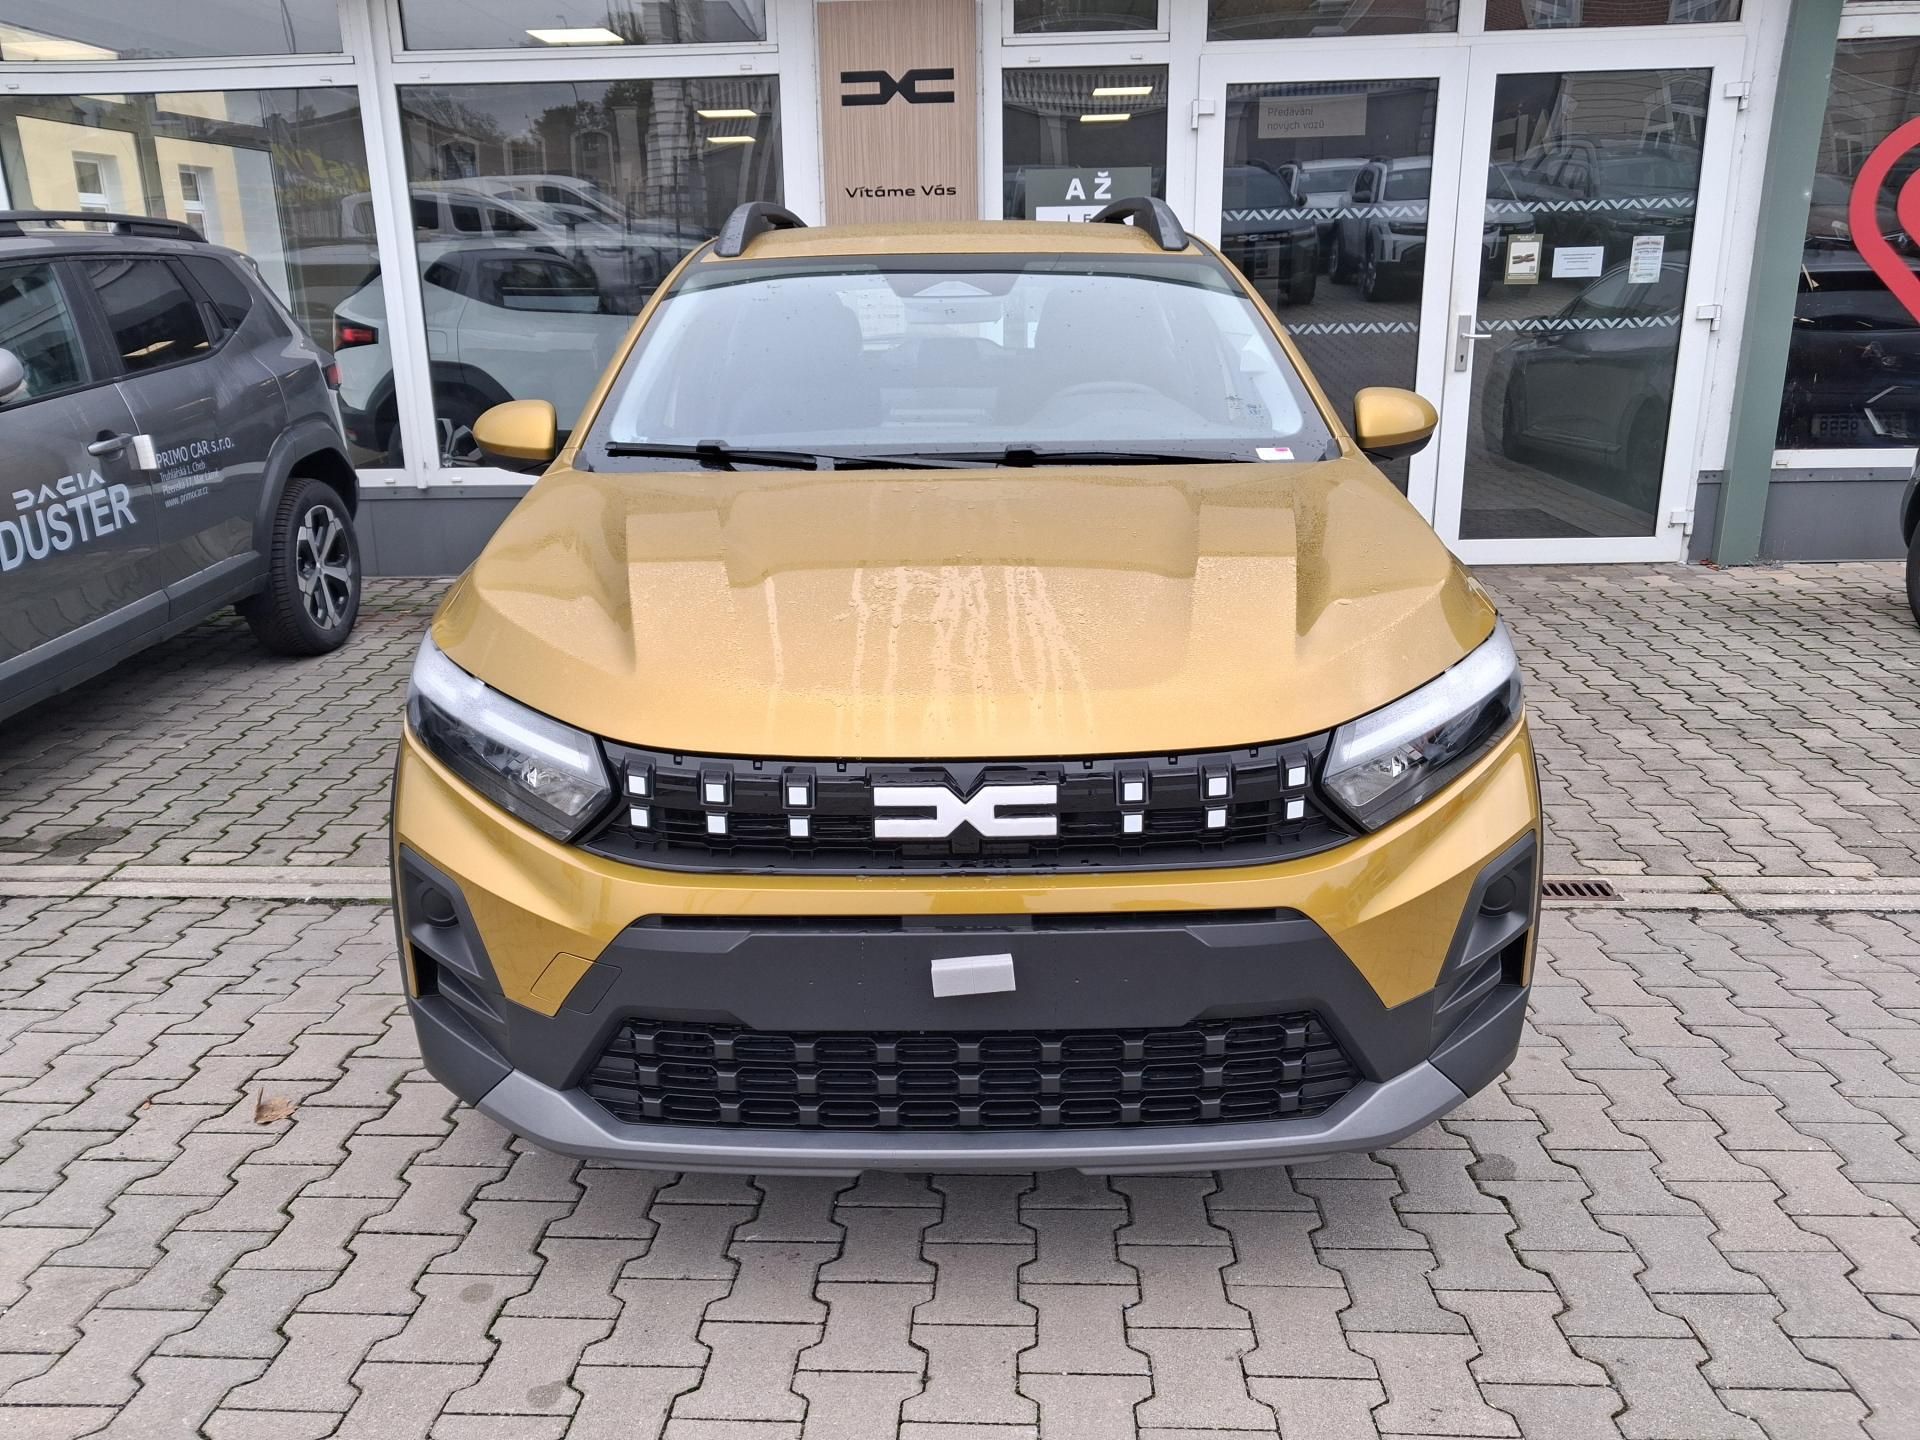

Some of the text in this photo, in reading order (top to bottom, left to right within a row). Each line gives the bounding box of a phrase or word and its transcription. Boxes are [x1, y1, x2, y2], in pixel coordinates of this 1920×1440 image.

[1267, 120, 1300, 132] nových
[845, 183, 957, 198] Vítáme Vás
[155, 436, 235, 469] PRIMO CAR s.r.o.
[192, 460, 206, 472] Cheb
[0, 483, 136, 572] DUSTER
